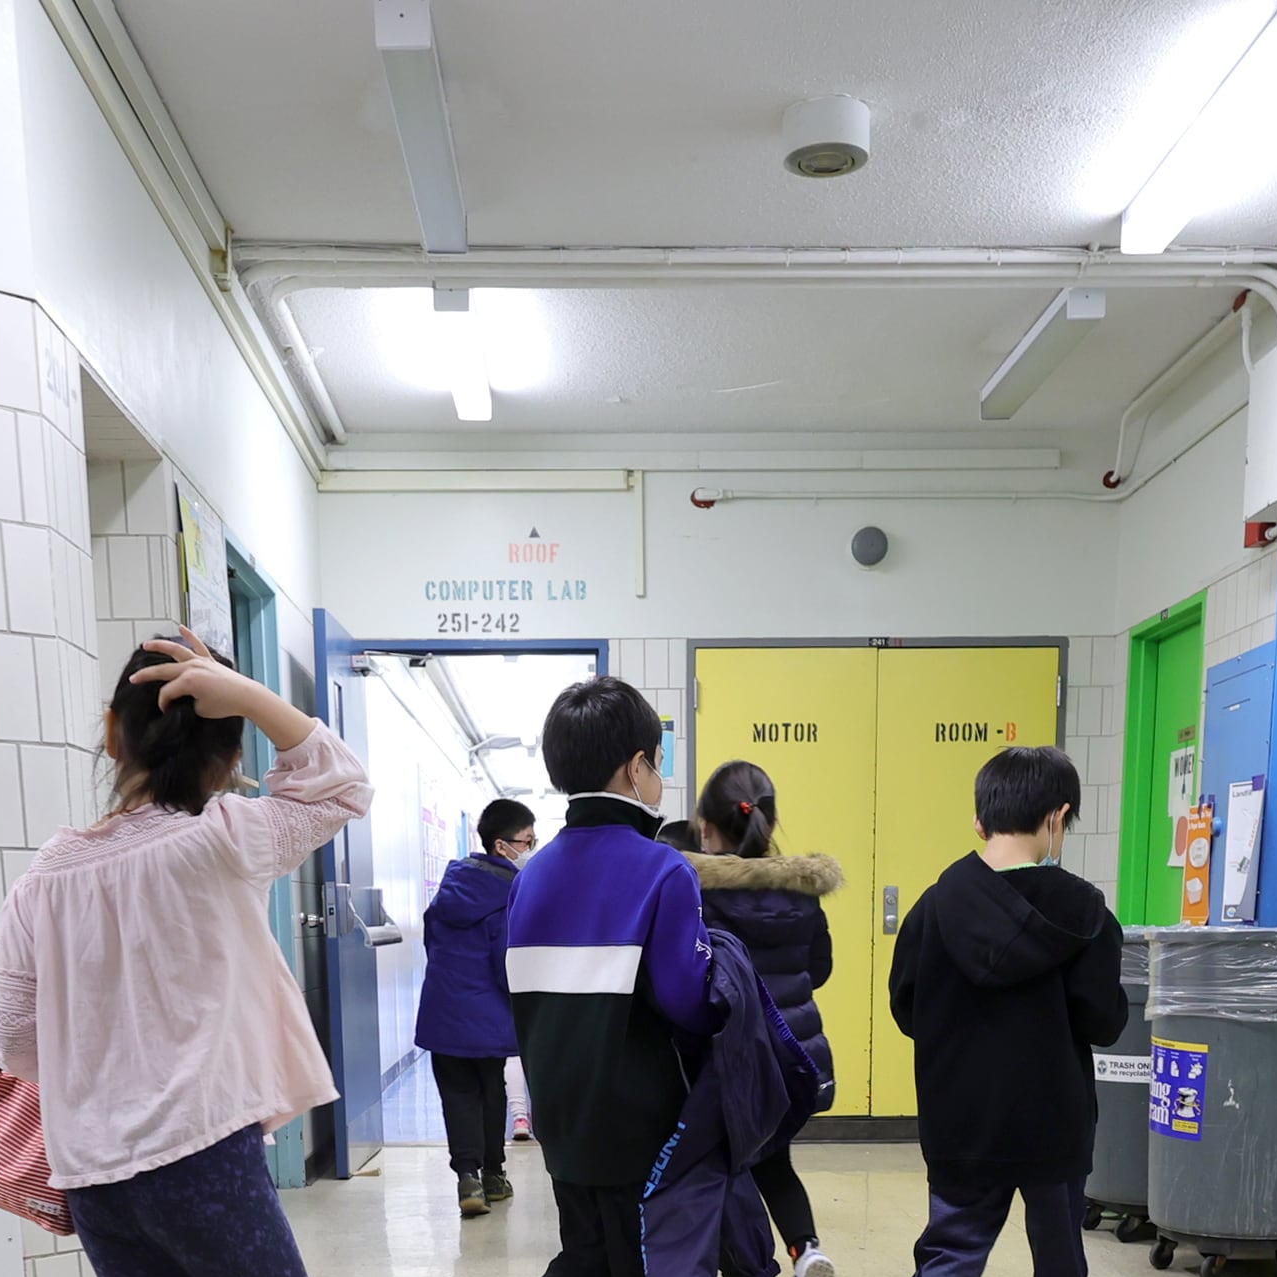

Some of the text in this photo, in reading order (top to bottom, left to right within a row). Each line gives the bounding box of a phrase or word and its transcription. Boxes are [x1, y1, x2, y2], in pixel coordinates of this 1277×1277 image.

[508, 543, 560, 563] ROOF
[425, 580, 587, 601] COMPUTER LAB
[437, 612, 520, 633] 251-242
[753, 722, 819, 743] MOTOR
[934, 722, 988, 742] ROOM
[1109, 1060, 1151, 1070] TRASH ON
